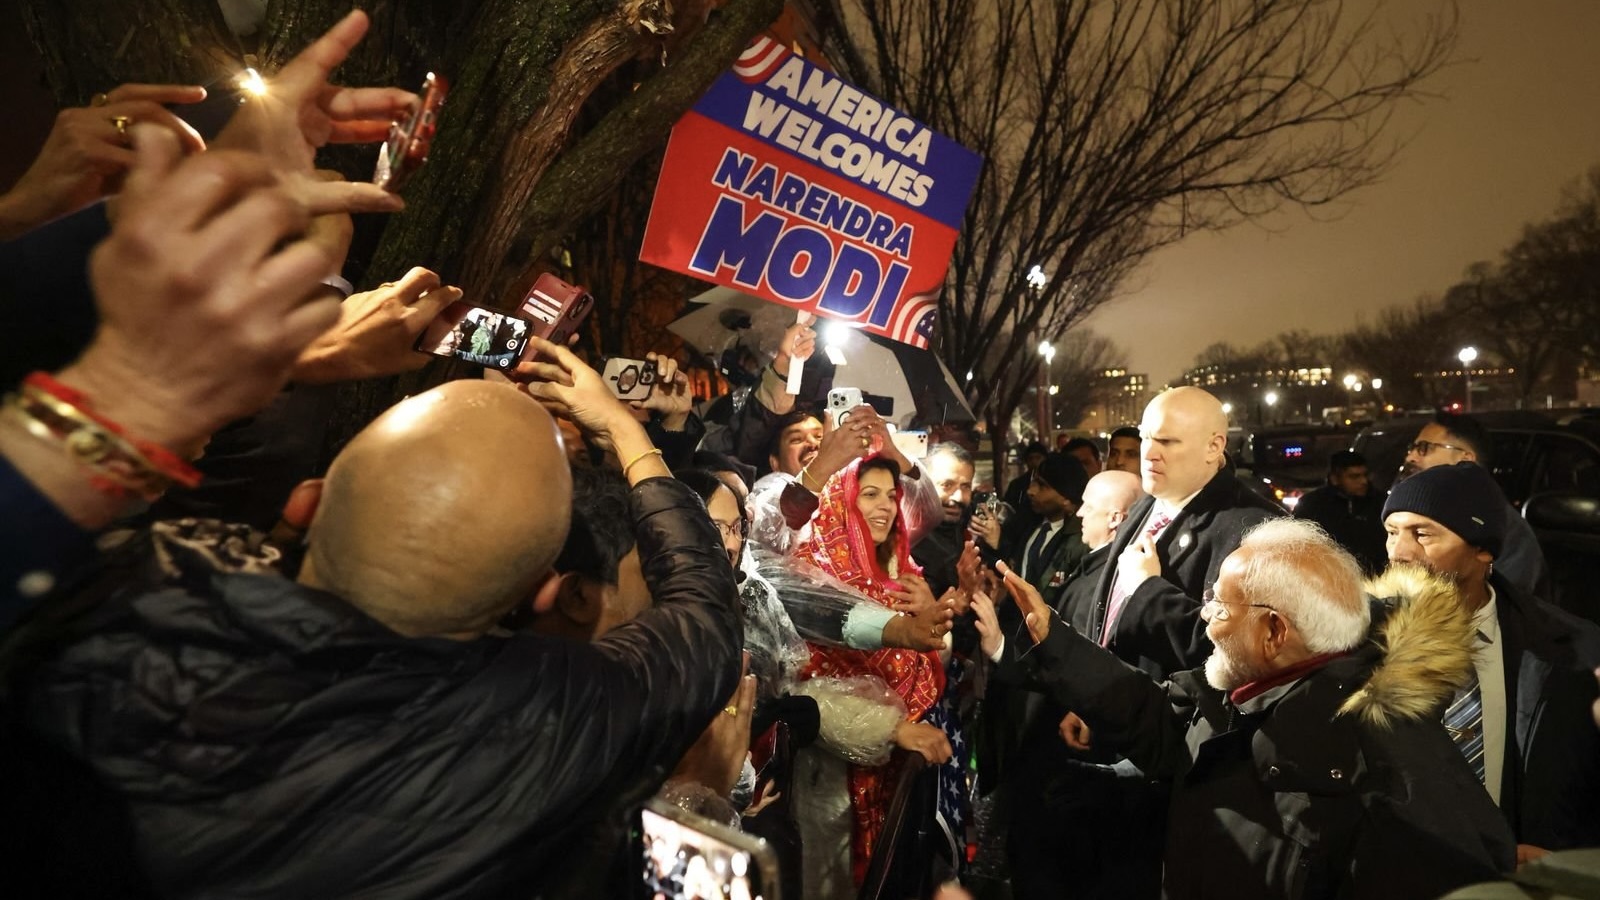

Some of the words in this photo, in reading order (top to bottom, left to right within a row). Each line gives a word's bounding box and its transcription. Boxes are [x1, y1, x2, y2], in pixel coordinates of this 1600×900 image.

[742, 90, 934, 206] WELCOMES
[766, 56, 934, 165] AMERICA
[712, 147, 914, 260] NARENDRA
[688, 193, 912, 330] MODI
